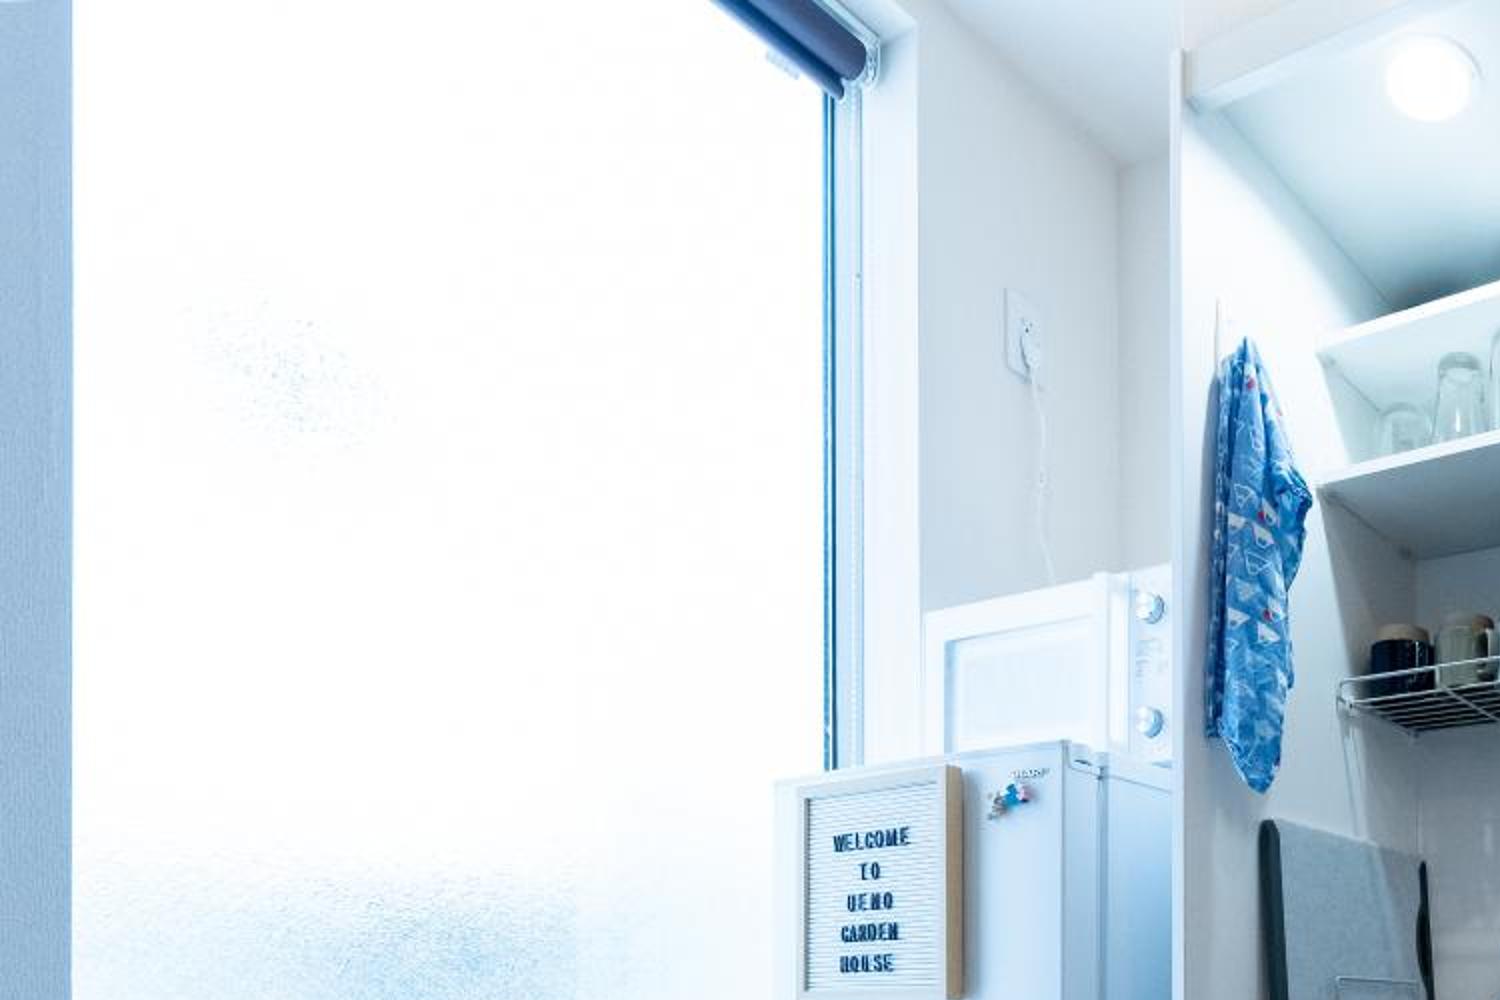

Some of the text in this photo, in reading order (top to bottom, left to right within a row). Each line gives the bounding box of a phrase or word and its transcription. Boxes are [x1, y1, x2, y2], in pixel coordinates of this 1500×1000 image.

[833, 826, 911, 853] WELCOME
[859, 862, 881, 881] TO
[847, 891, 894, 913] UENO
[841, 922, 899, 944] GARDEN
[839, 953, 896, 974] HOUSE
